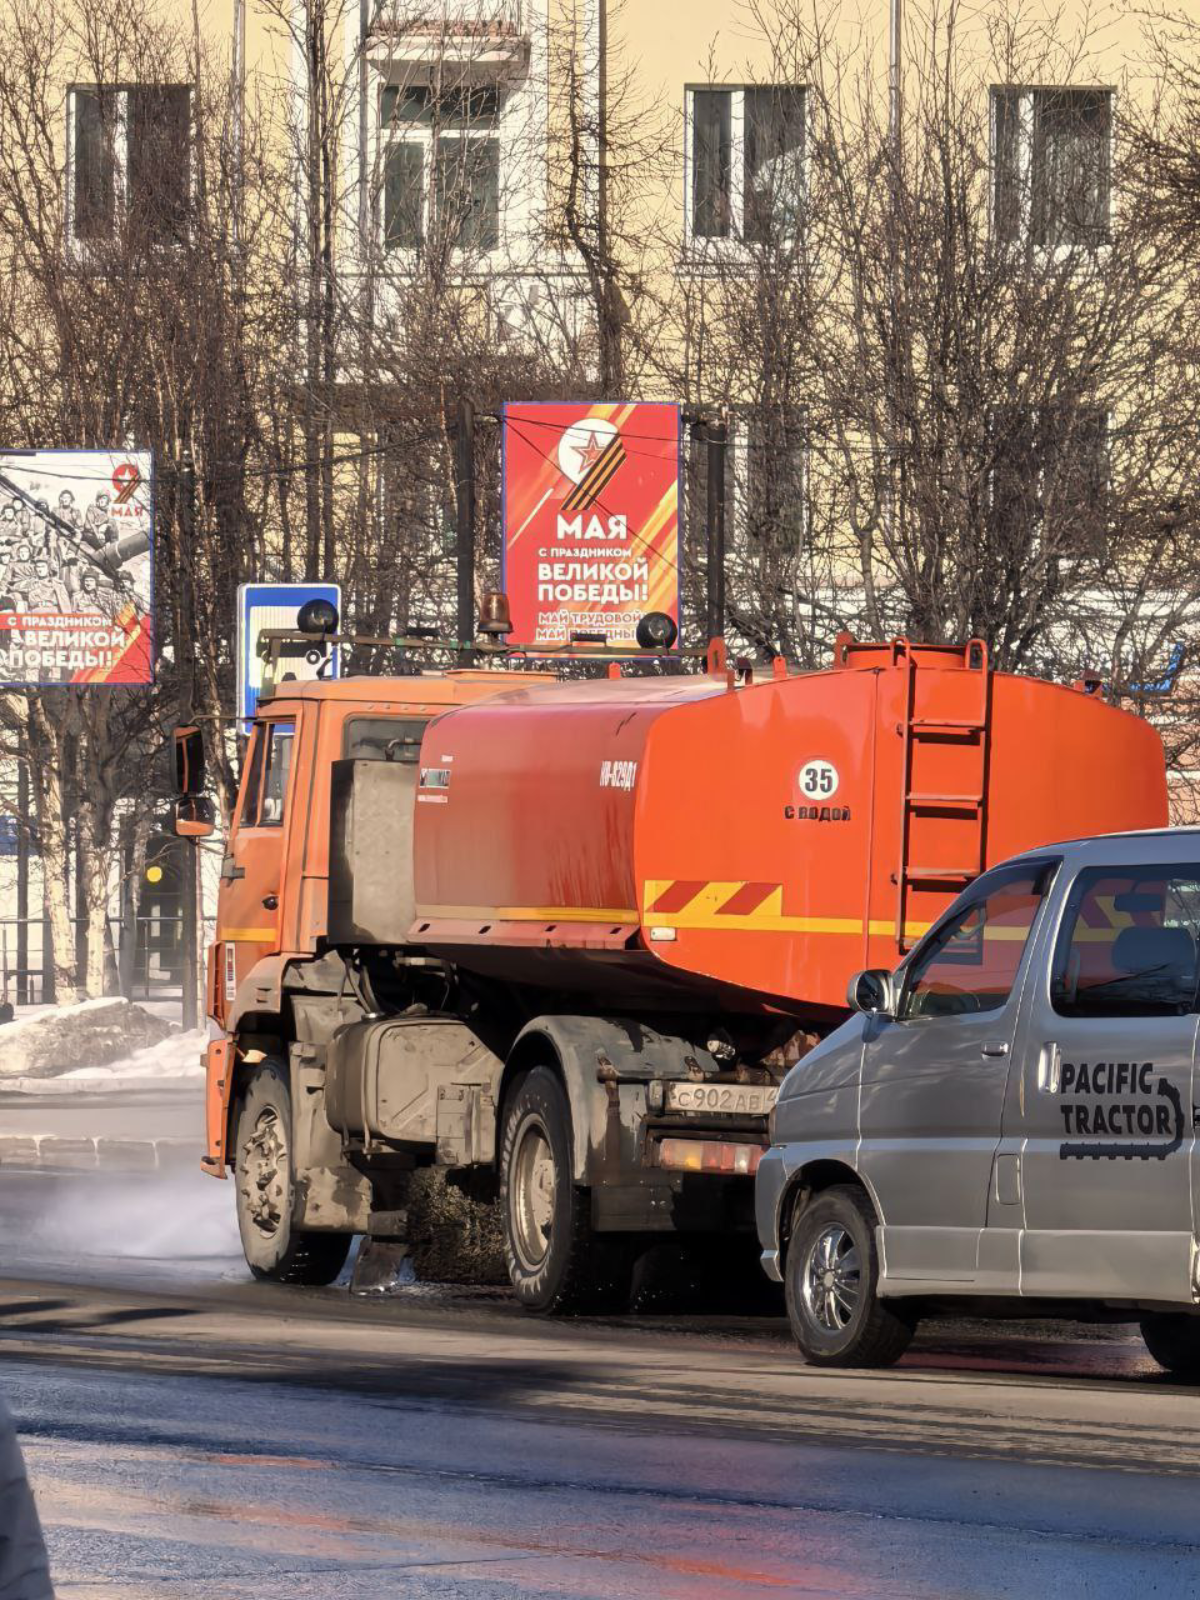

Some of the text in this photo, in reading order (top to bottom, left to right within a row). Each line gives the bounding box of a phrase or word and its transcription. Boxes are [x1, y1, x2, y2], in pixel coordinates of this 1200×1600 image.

[111, 505, 143, 517] МАЯ
[556, 514, 628, 540] МАЯ
[538, 547, 632, 559] С ПРАЗДНИКОМ
[538, 558, 649, 581] ВЕЛИКОЙ
[538, 584, 649, 605] ПОБЕДЫ!
[7, 616, 113, 628] С ПРАЗДНИКОМ
[538, 609, 569, 625] МАЙ
[24, 625, 126, 647] ВЕЛИКОЙ
[535, 625, 567, 641] МАЙ
[9, 649, 113, 670] ПОБЕДЫ!
[804, 767, 833, 793] 35
[784, 805, 795, 820] С
[1060, 1062, 1154, 1095] PACIFIC
[1060, 1104, 1173, 1135] TRACTOR
